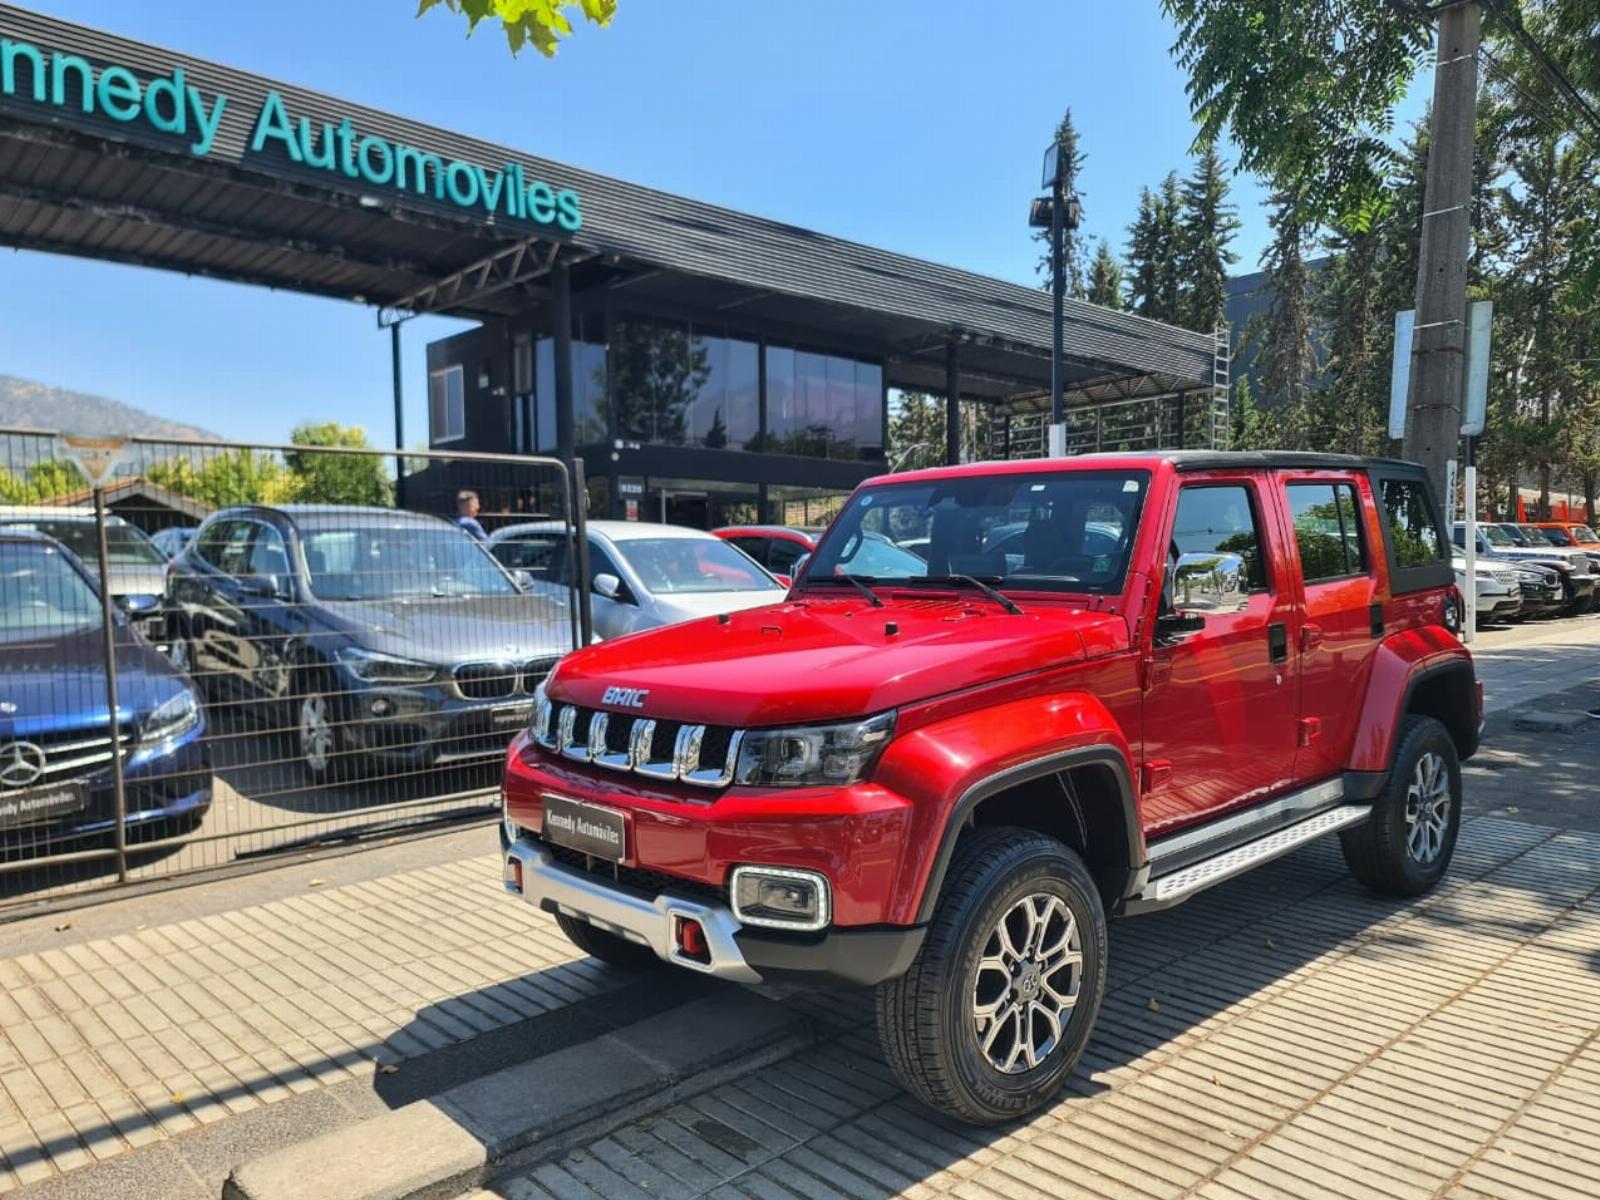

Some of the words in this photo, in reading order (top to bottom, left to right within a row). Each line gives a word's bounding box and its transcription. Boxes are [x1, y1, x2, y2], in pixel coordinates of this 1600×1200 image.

[251, 91, 583, 233] Automoviles
[601, 686, 650, 708] BAIC
[546, 809, 576, 834] Kennedy
